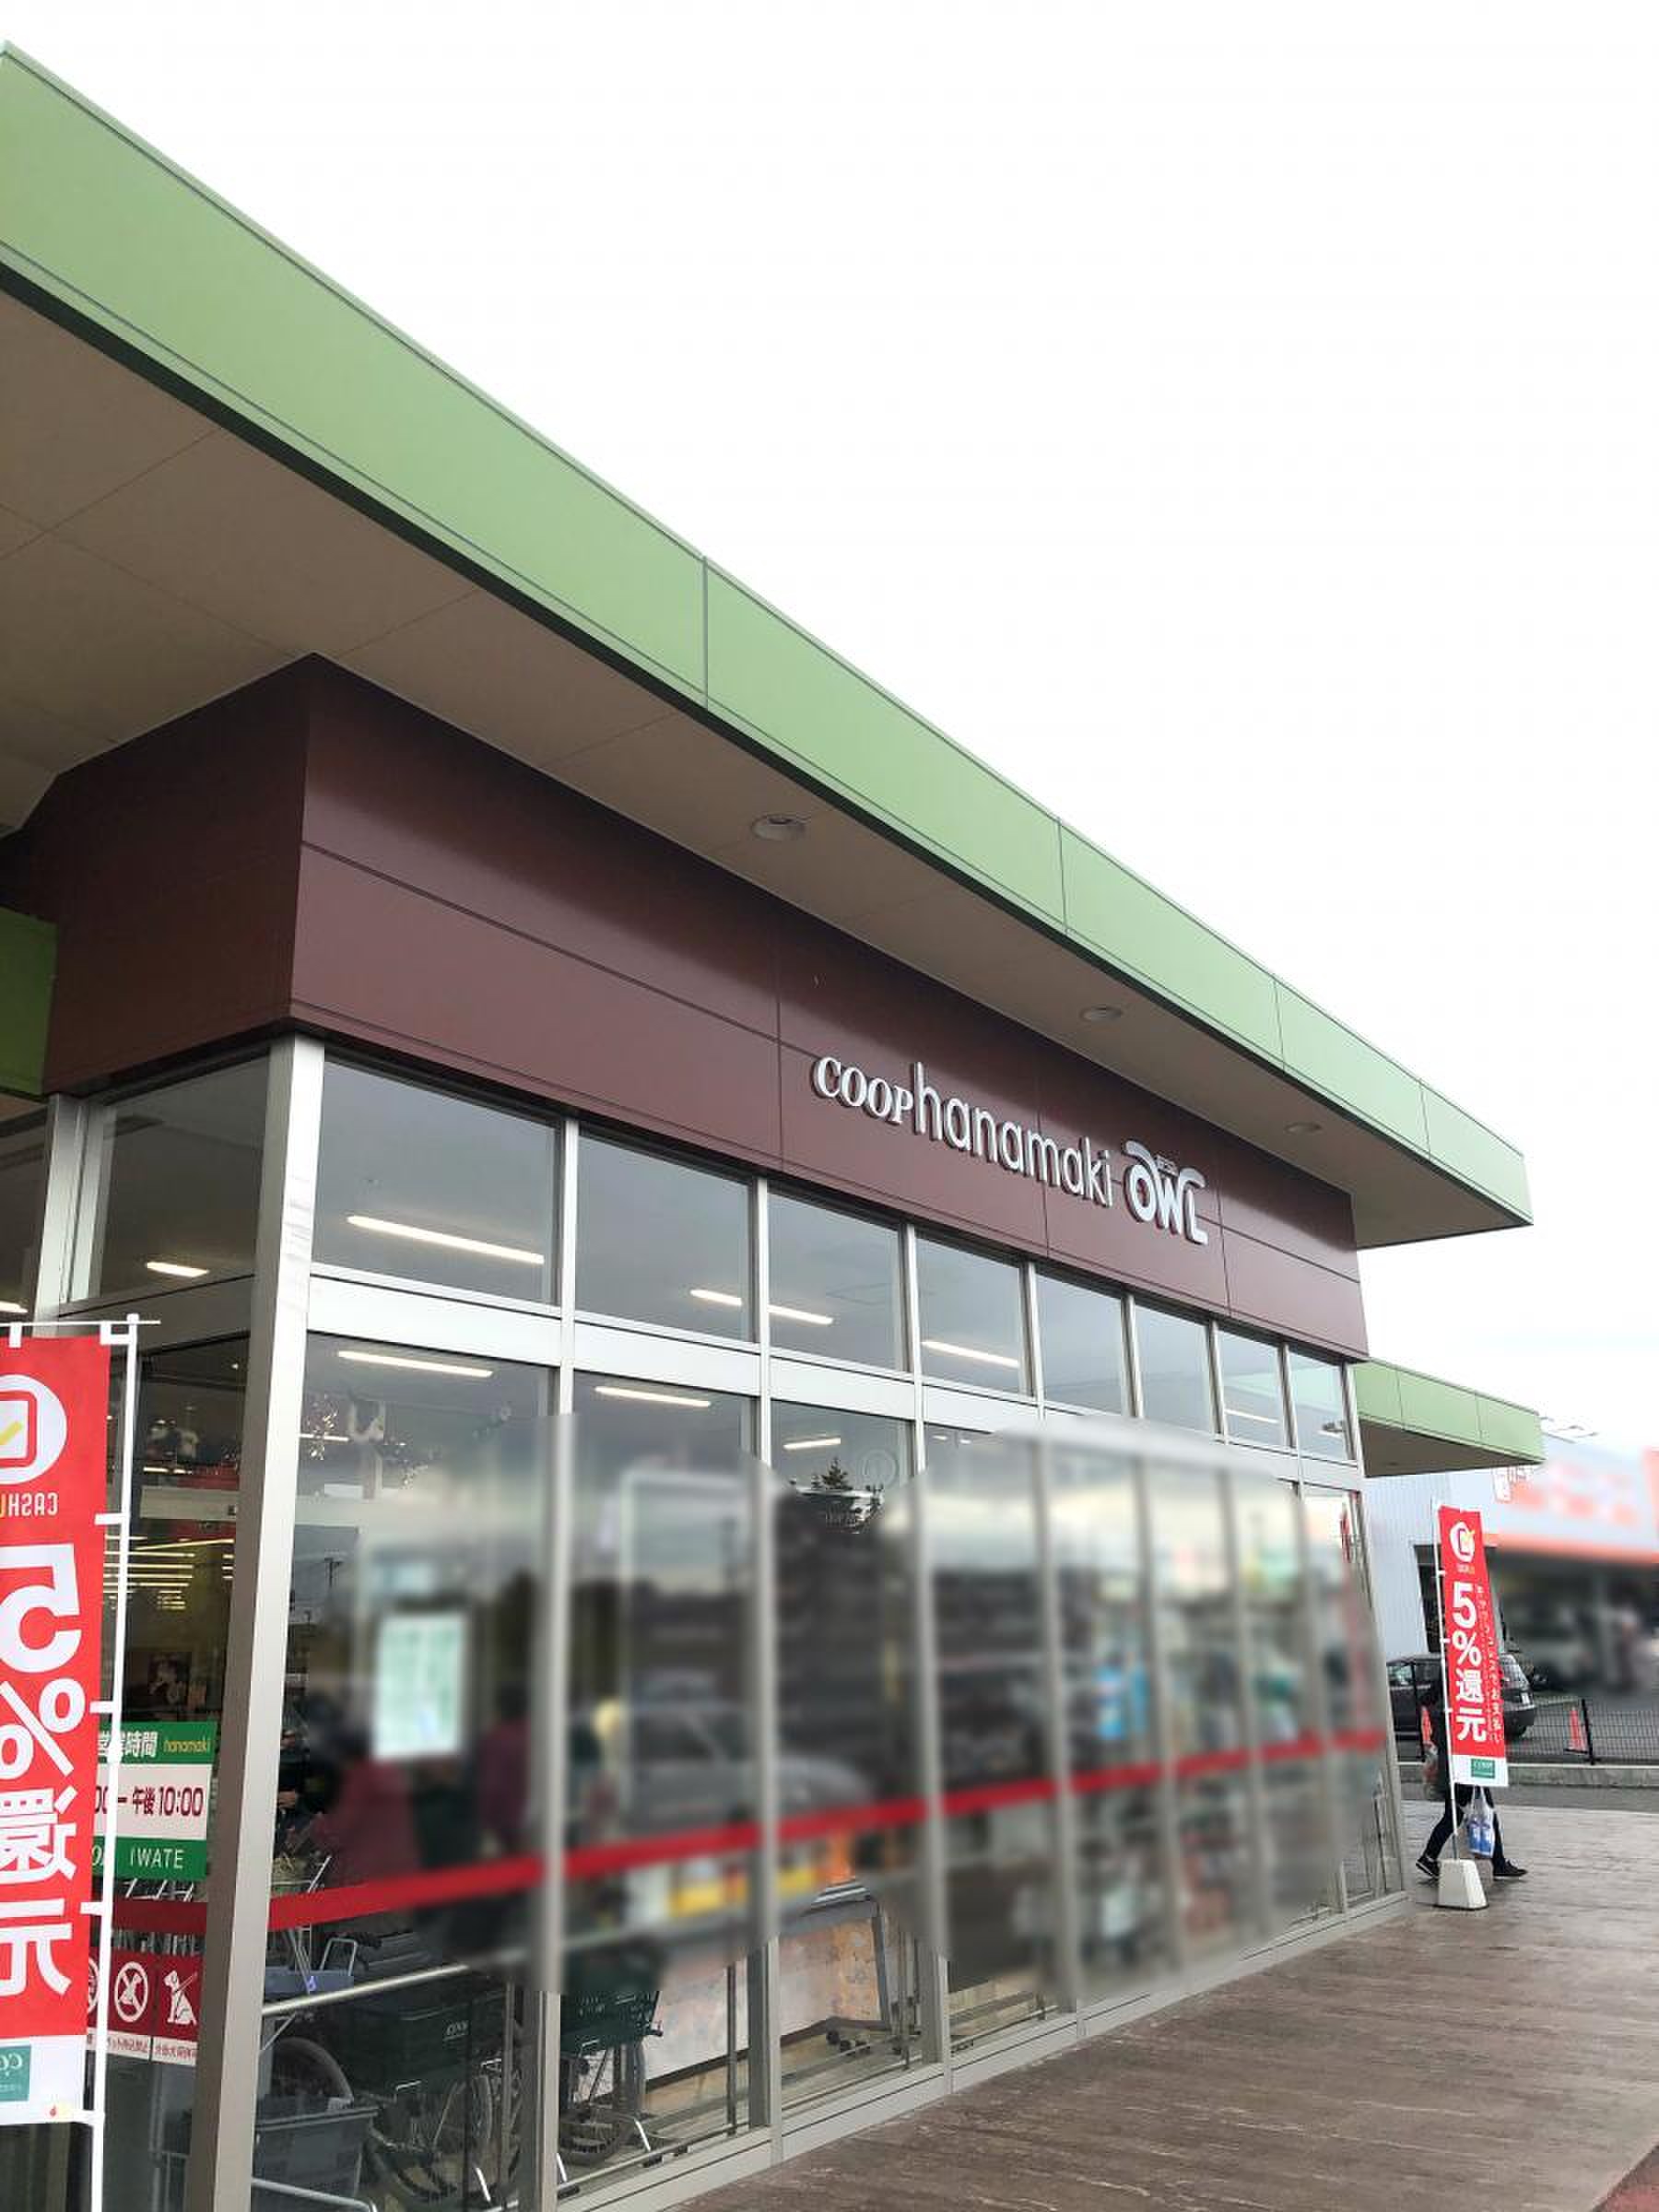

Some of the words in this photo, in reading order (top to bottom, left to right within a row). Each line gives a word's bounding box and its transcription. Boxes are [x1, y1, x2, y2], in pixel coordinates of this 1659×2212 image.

[813, 1056, 913, 1124] COOP
[913, 1061, 1113, 1207] hanamaki
[1452, 1581, 1487, 1742] 5%還元
[130, 1847, 185, 1869] IWATE
